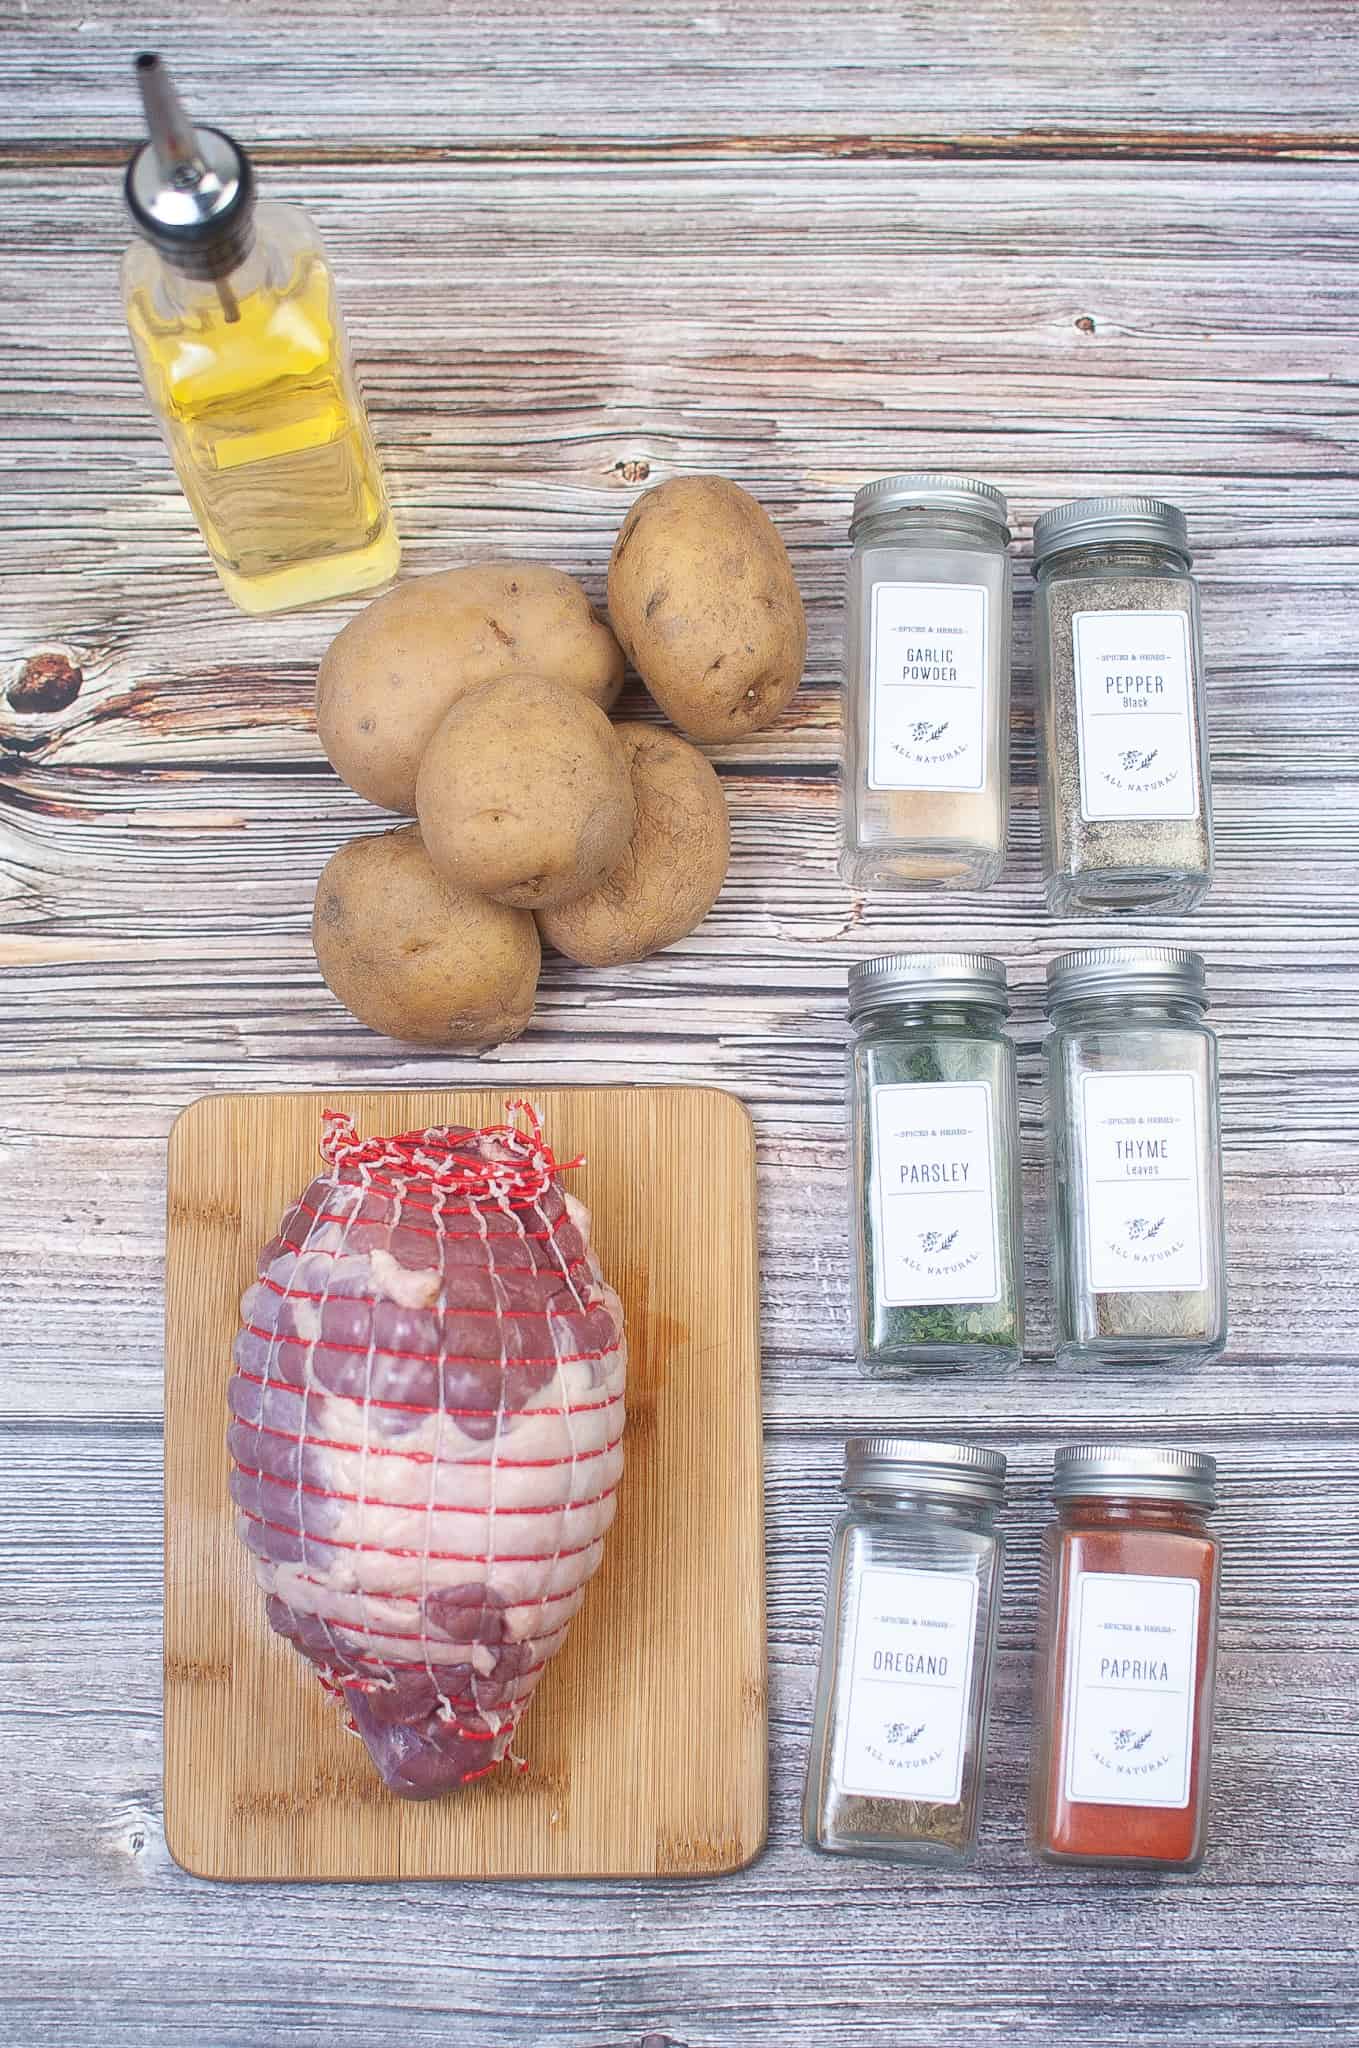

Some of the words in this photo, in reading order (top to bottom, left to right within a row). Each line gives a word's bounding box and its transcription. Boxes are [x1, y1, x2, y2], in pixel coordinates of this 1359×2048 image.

[907, 649, 953, 663] GARLIC
[903, 666, 956, 680] POWDER
[1106, 675, 1163, 694] PEPPER
[1123, 697, 1148, 708] Black
[892, 744, 911, 759] ALL
[917, 745, 966, 764] NATURAL
[1104, 774, 1122, 788] ALL
[1128, 772, 1177, 792] NATURAL
[1116, 1140, 1168, 1159] THYME
[900, 1163, 969, 1183] PARSLEY
[1126, 1164, 1159, 1175] Leaves
[1110, 1244, 1128, 1258] ALL
[1134, 1241, 1184, 1262] NATURAL
[902, 1256, 920, 1271] ALL
[928, 1253, 978, 1275] NATURAL
[873, 1650, 948, 1676] OREGANO
[1101, 1658, 1168, 1680] PAPRIKA
[889, 1750, 942, 1768] NATURAL
[1094, 1752, 1111, 1768] ALL
[1117, 1756, 1168, 1775] NATURAL
